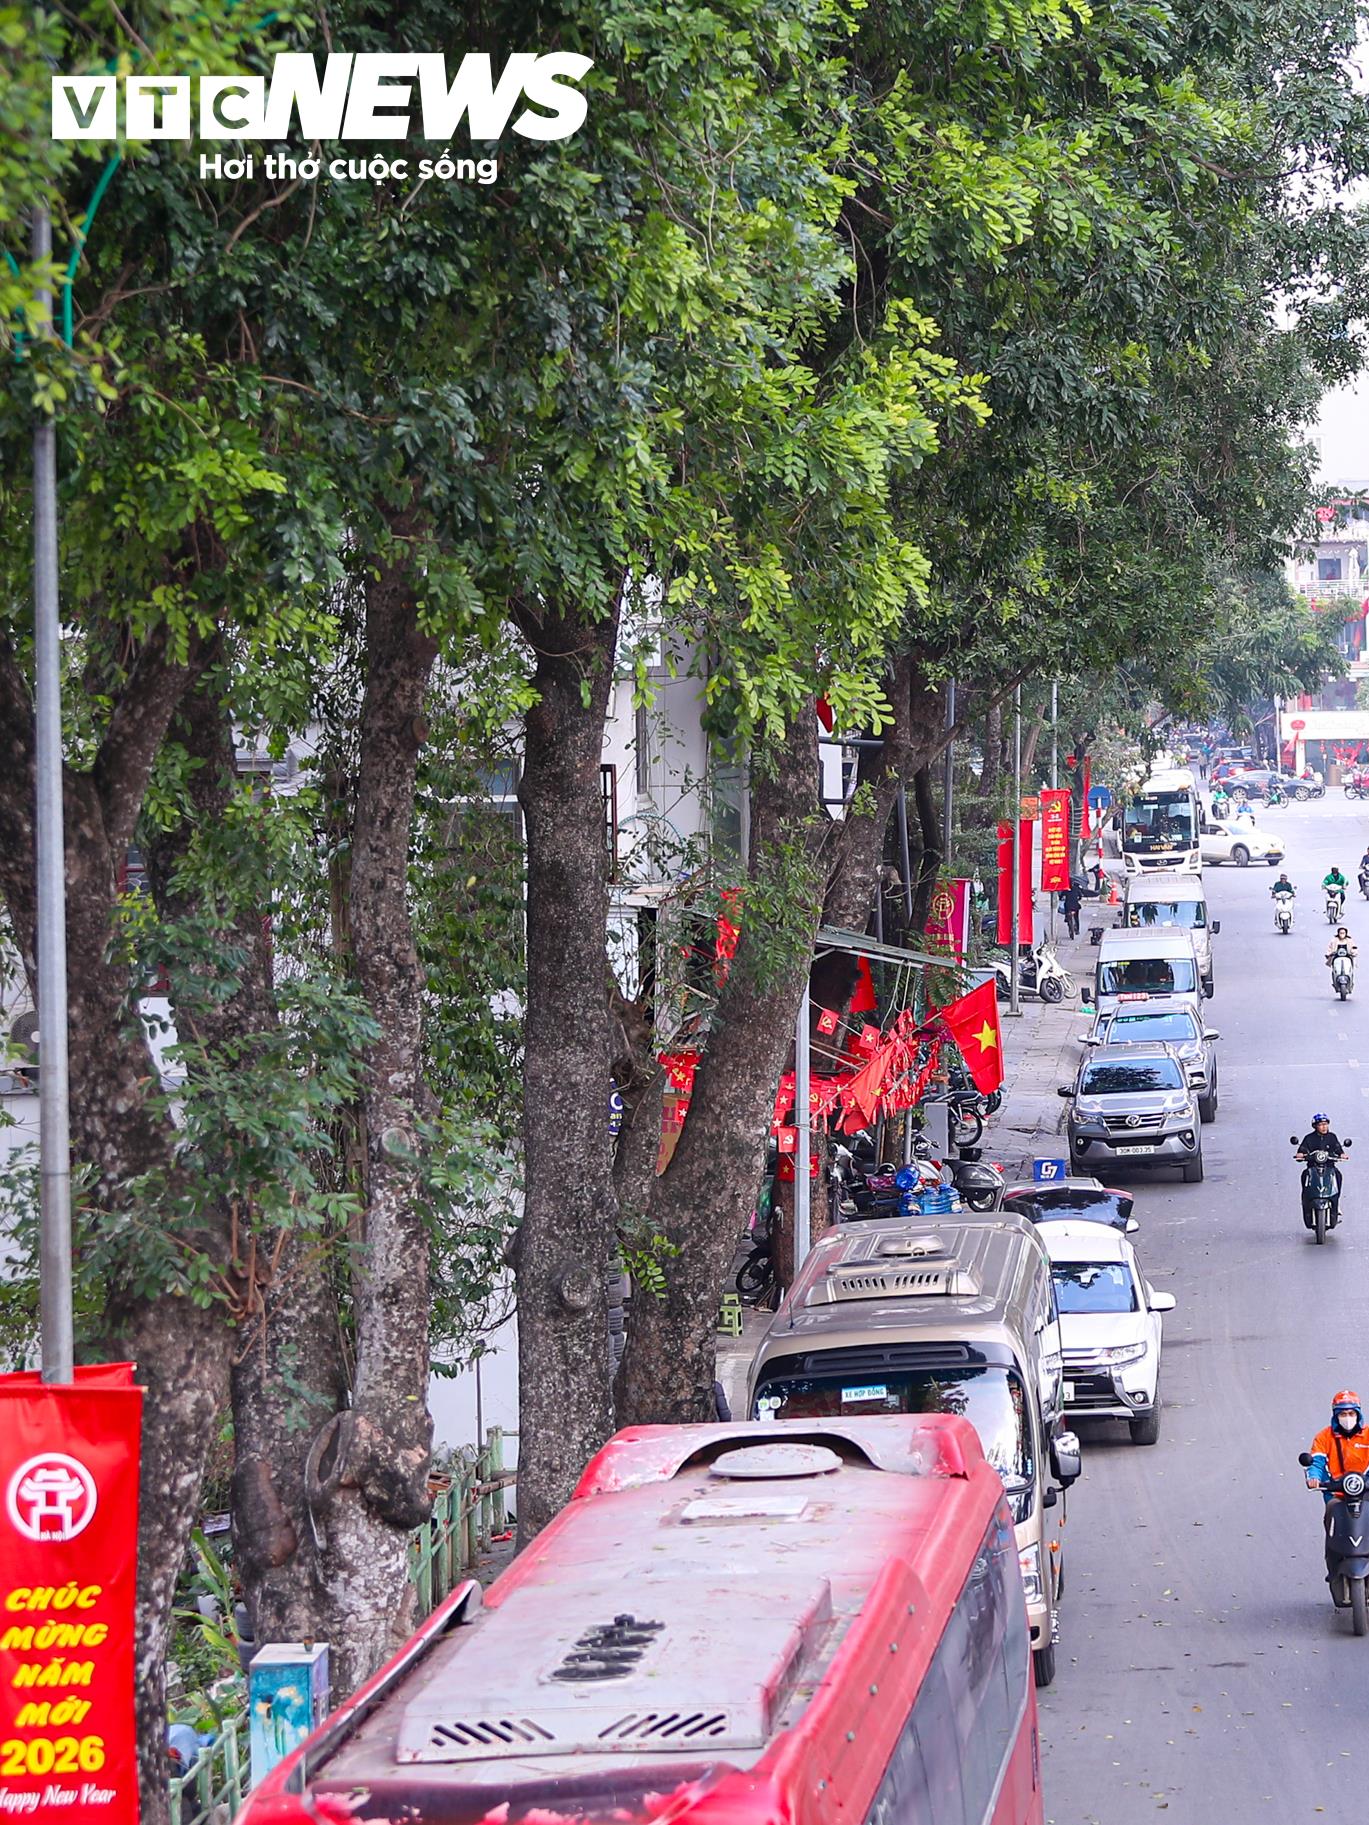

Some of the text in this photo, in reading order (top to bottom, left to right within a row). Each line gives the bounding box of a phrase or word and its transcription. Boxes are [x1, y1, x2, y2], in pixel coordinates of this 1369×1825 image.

[5, 1581, 102, 1611] CHÚC
[0, 1619, 109, 1650] MỪNG
[12, 1657, 96, 1688] NĂM
[14, 1695, 93, 1728] MỚI
[1, 1735, 105, 1776] 2026
[41, 1784, 79, 1807] New
[80, 1783, 117, 1806] Year
